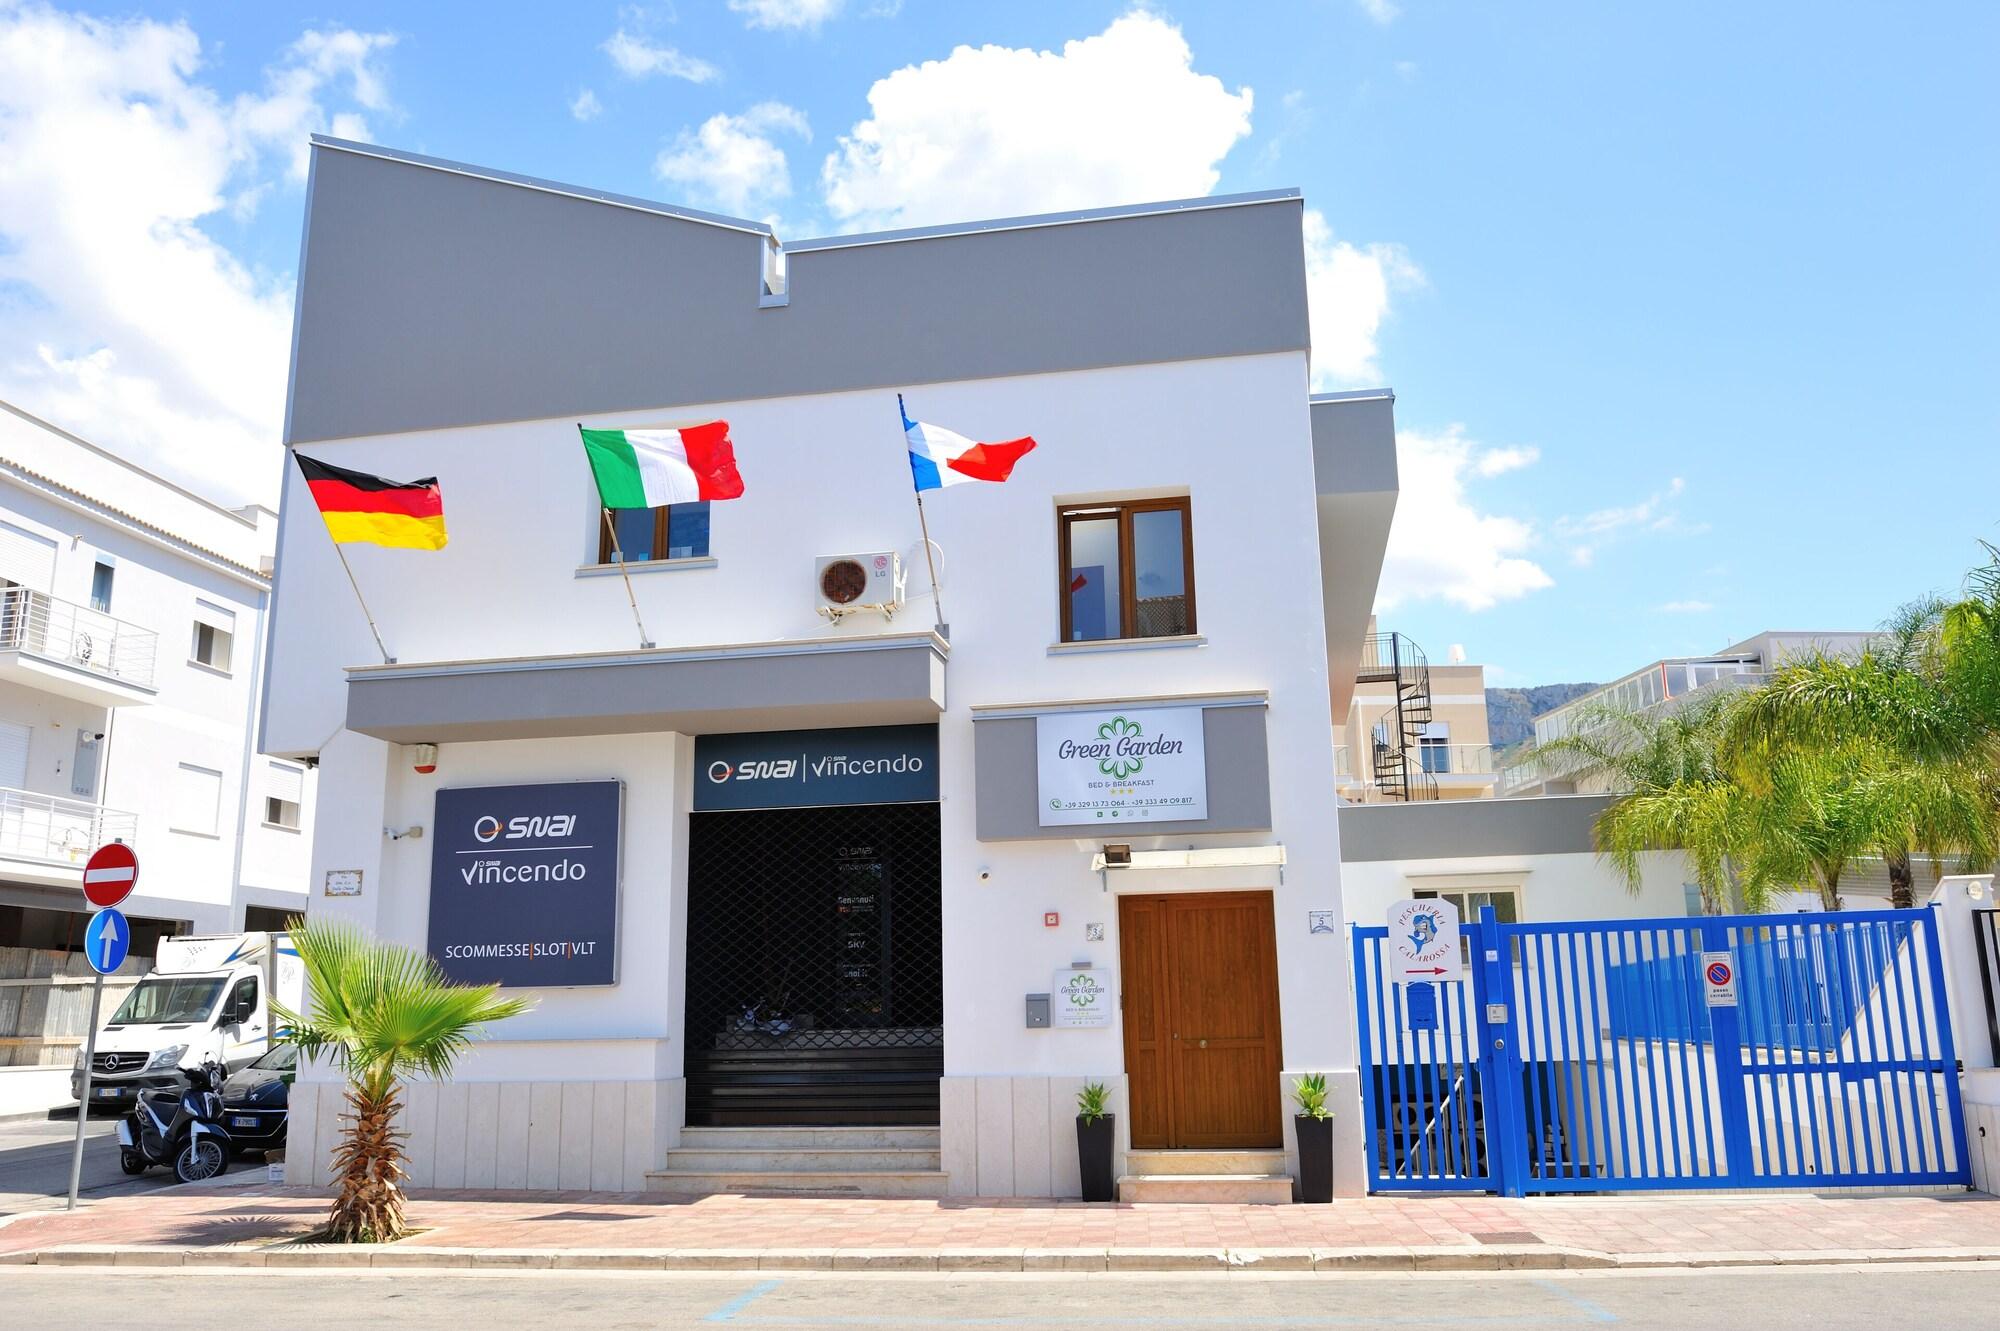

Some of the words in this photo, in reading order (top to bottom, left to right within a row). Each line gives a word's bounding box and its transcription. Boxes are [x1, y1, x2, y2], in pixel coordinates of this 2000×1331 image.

[875, 570, 886, 578] LG
[1059, 739, 1111, 760] Green
[1116, 733, 1183, 757] Garden
[1112, 779, 1154, 788] BREAKFAST
[1398, 904, 1447, 926] PESCHERIA
[1318, 916, 1325, 926] 5
[1092, 927, 1098, 937] 3
[445, 943, 530, 959] SCOMMESSE
[533, 942, 568, 956] SLOT
[571, 941, 596, 955] VLT
[1398, 943, 1451, 962] CALAROSSA
[1060, 986, 1080, 994] Green
[1081, 985, 1105, 994] Garden
